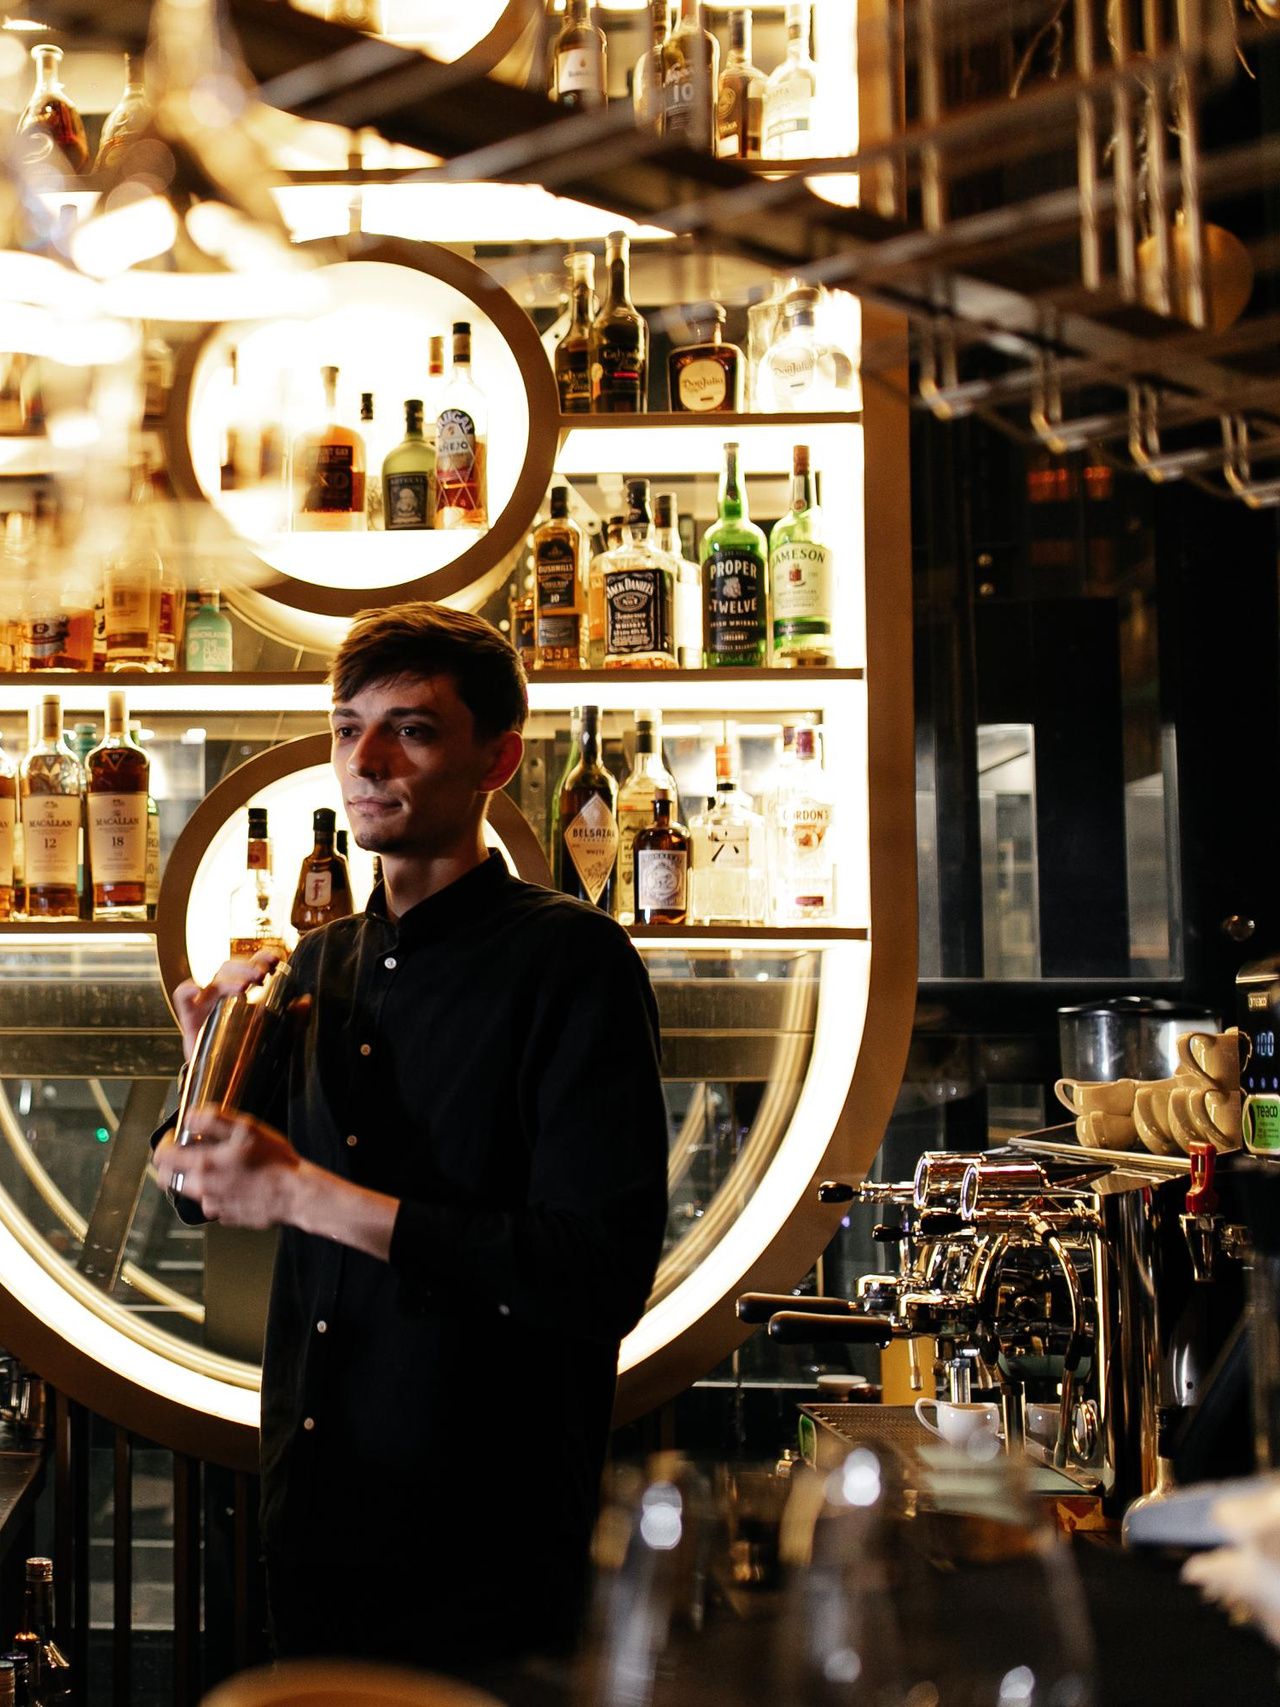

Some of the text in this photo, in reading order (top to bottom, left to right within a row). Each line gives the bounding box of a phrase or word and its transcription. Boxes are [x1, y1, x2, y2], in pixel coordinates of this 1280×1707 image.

[538, 563, 573, 574] BUSHMILLS
[710, 559, 757, 580] PROPER
[711, 597, 758, 614] TWELVE
[29, 820, 72, 828] MACALLAN
[96, 818, 140, 826] MACALLAN
[44, 837, 57, 849] 12
[111, 836, 124, 847] 18
[1256, 1032, 1274, 1057] 100
